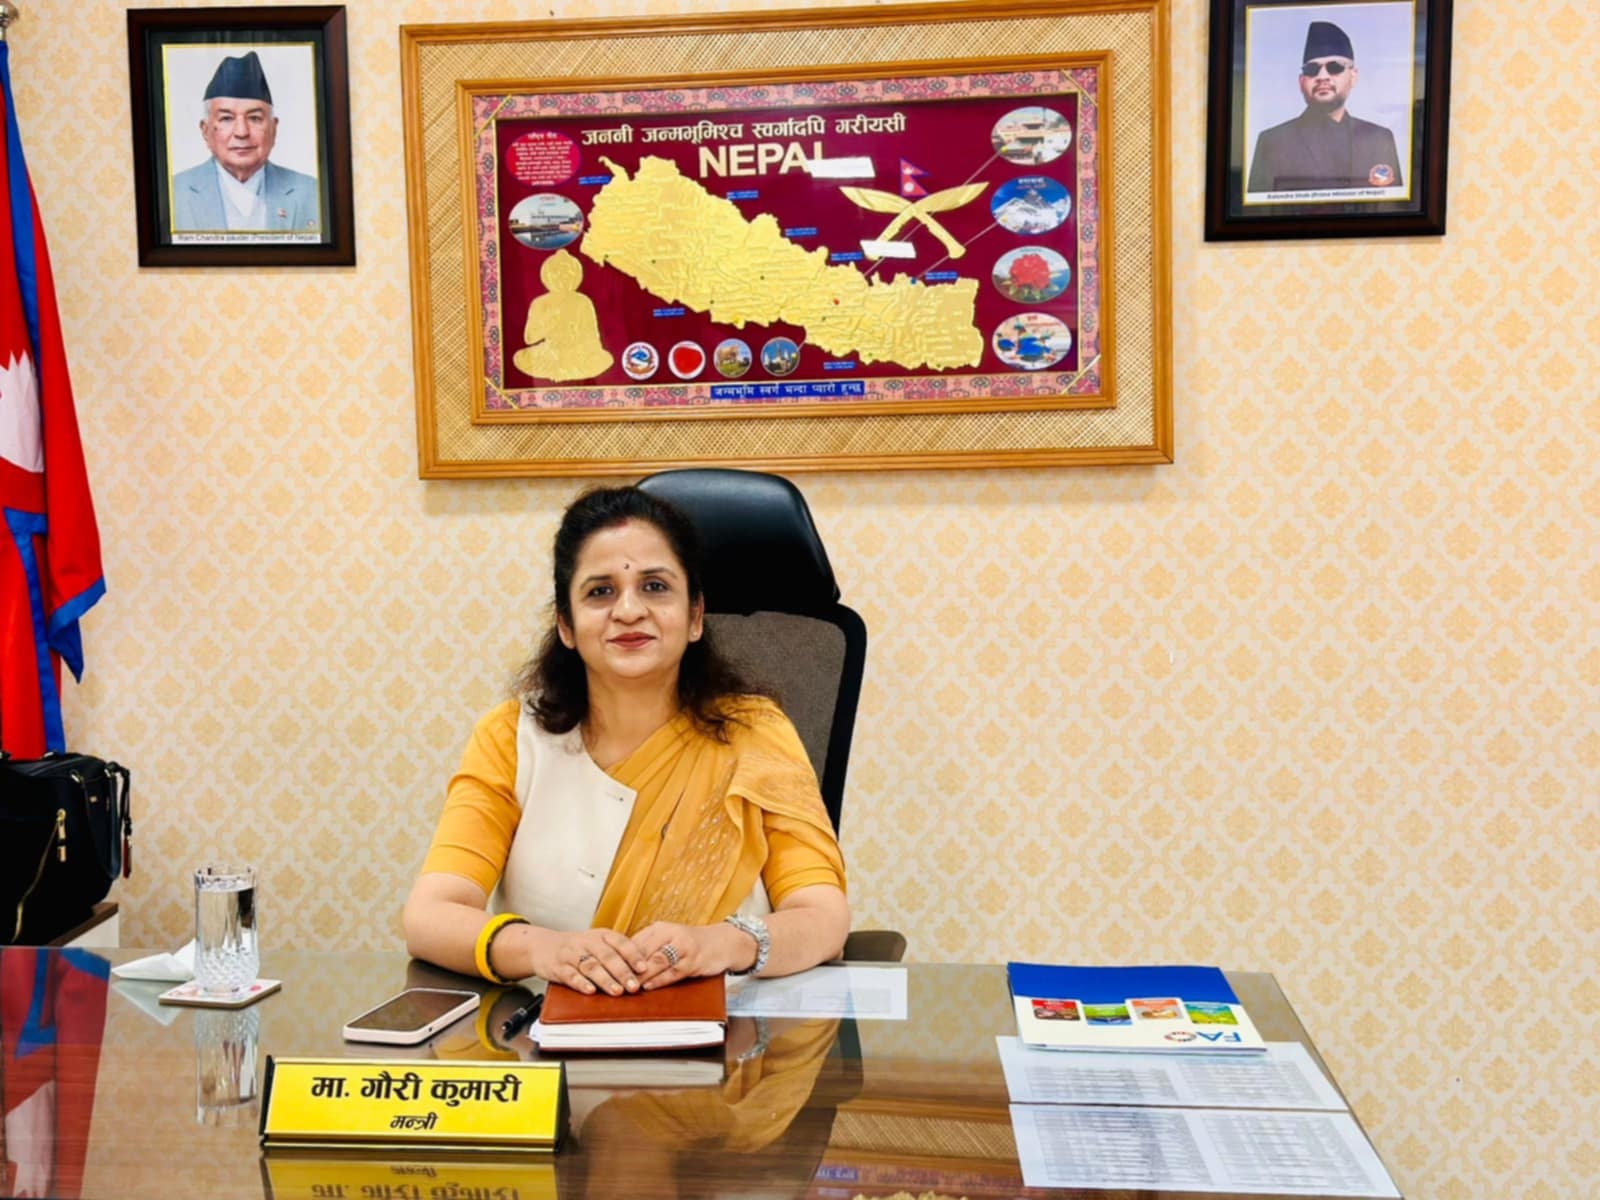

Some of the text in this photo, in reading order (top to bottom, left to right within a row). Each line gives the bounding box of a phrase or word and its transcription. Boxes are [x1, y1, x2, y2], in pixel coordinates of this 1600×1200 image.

[581, 112, 907, 146] जननी जन्मभूमिश्च स्वर्गादपि गरीयसी
[311, 1071, 522, 1107] मा. गौरी कुमारी
[390, 1112, 439, 1130] मन्त्री
